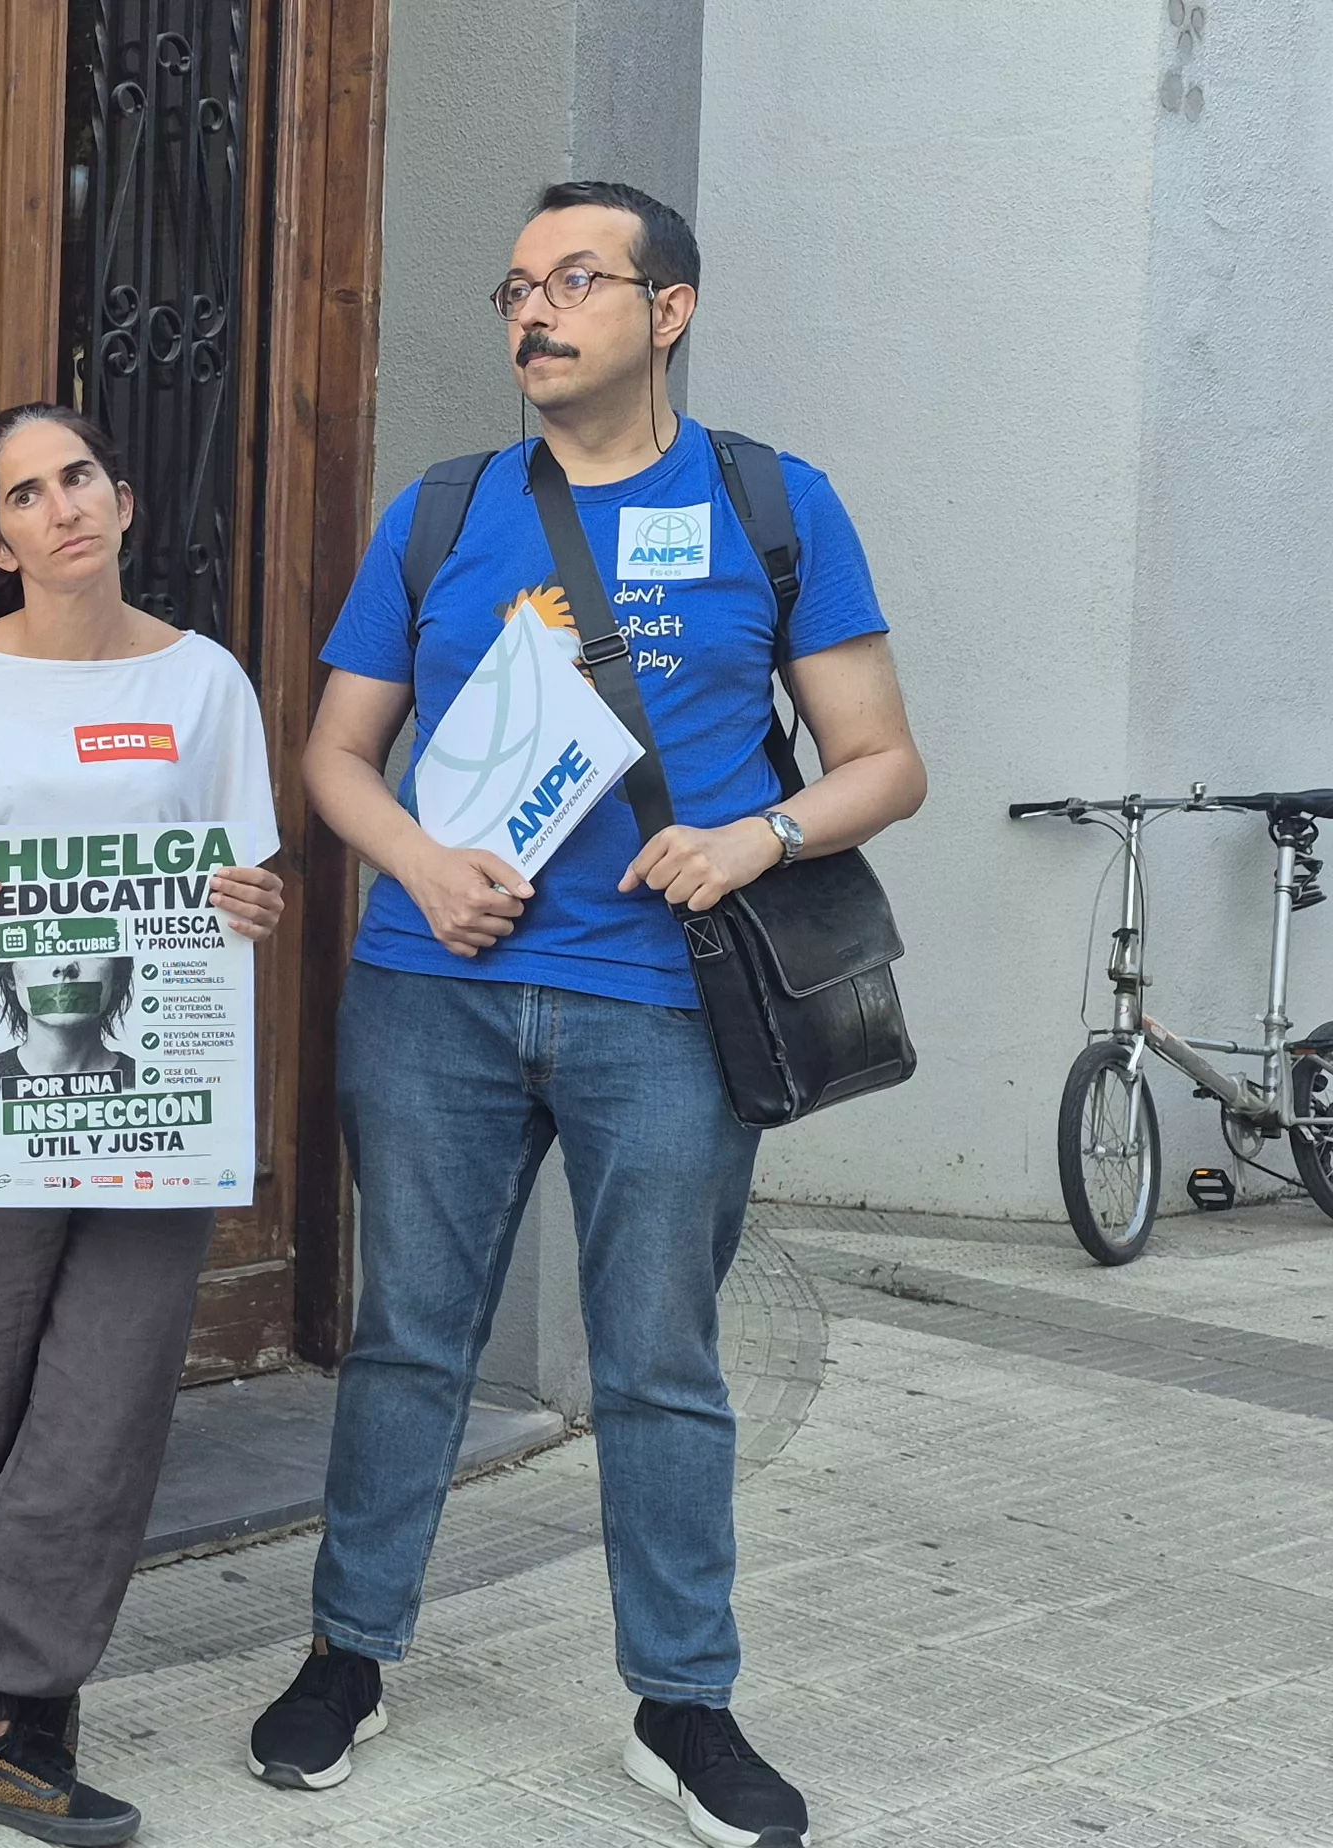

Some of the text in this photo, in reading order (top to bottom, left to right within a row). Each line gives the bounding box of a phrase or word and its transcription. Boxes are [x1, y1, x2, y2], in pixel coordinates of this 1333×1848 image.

[629, 544, 704, 563] ANPE
[614, 615, 683, 638] oRGEt
[79, 734, 147, 751] CCOO
[507, 739, 593, 855] ANPE
[521, 766, 600, 867] SINDICATO INDEPENDIENTE
[33, 921, 61, 940] 14
[134, 915, 220, 935] HUESCA
[35, 936, 116, 954] DE OCTUBRE
[135, 936, 225, 950] Y PROVINCIA
[162, 994, 211, 1003] UNIFICACIÓN
[163, 1030, 235, 1039] REVISIÓN EXTERNA
[163, 1048, 205, 1056] IMPUESTAS
[16, 1074, 115, 1098] POR UNA
[13, 1094, 203, 1132] INSPECCIÓN
[28, 1130, 185, 1158] ÚTIL Y JUSTA
[162, 1177, 181, 1186] UGT
